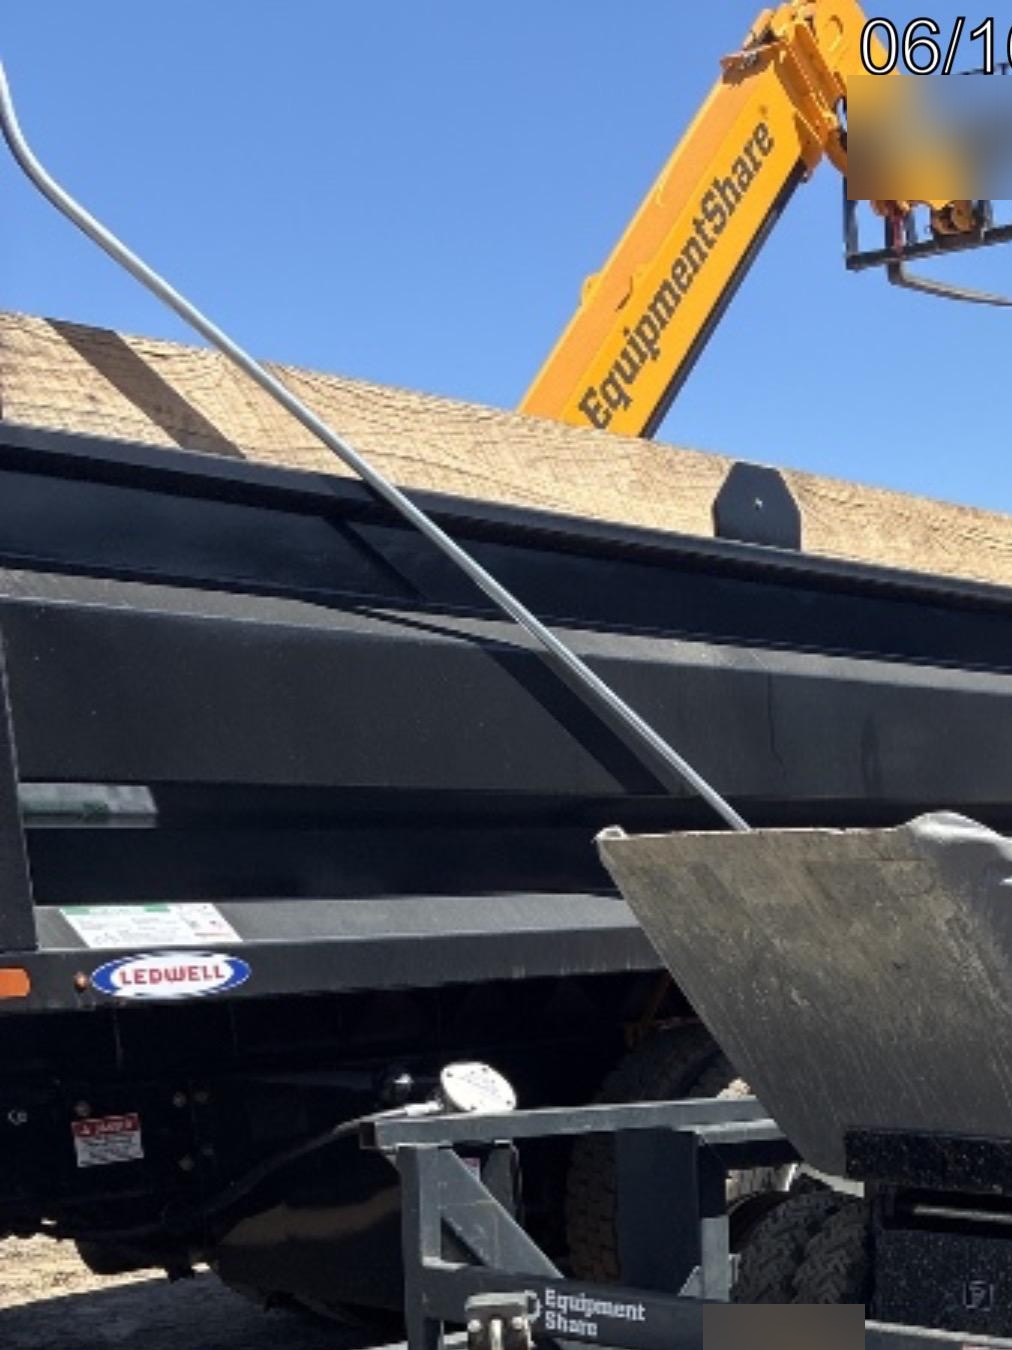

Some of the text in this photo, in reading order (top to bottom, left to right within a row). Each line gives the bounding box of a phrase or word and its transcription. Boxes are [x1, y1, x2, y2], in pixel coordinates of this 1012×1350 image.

[578, 121, 775, 430] EquipmentShare
[118, 965, 226, 985] LEDWELL
[545, 1287, 646, 1321] Equipment
[545, 1310, 598, 1336] Share
